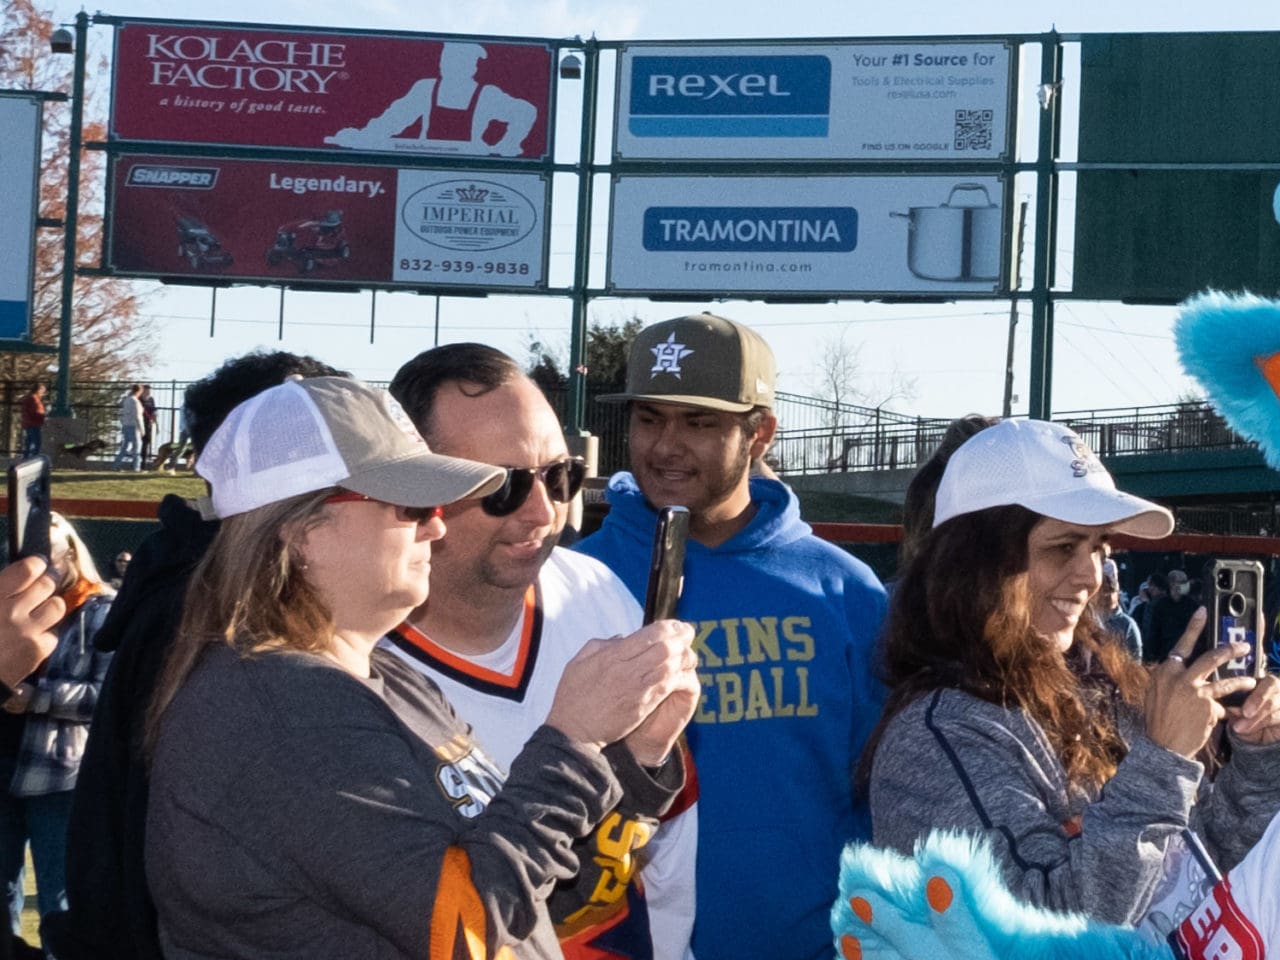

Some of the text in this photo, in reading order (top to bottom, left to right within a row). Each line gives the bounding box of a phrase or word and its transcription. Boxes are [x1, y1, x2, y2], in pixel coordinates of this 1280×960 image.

[144, 33, 346, 67] KOLACHE
[853, 52, 996, 67] Your #1 Source for
[852, 76, 994, 88] Tools & Electrical Supplies
[159, 97, 169, 106] a
[174, 95, 224, 112] history
[229, 97, 246, 112] of
[248, 101, 283, 114] good
[132, 168, 212, 186] SNAPPER
[269, 173, 386, 198] Legendary.
[423, 206, 519, 224] IMPERIAL
[660, 219, 841, 242] TRAMONTINA
[400, 259, 529, 275] 832-939-9838
[684, 260, 812, 273] tramontina.com
